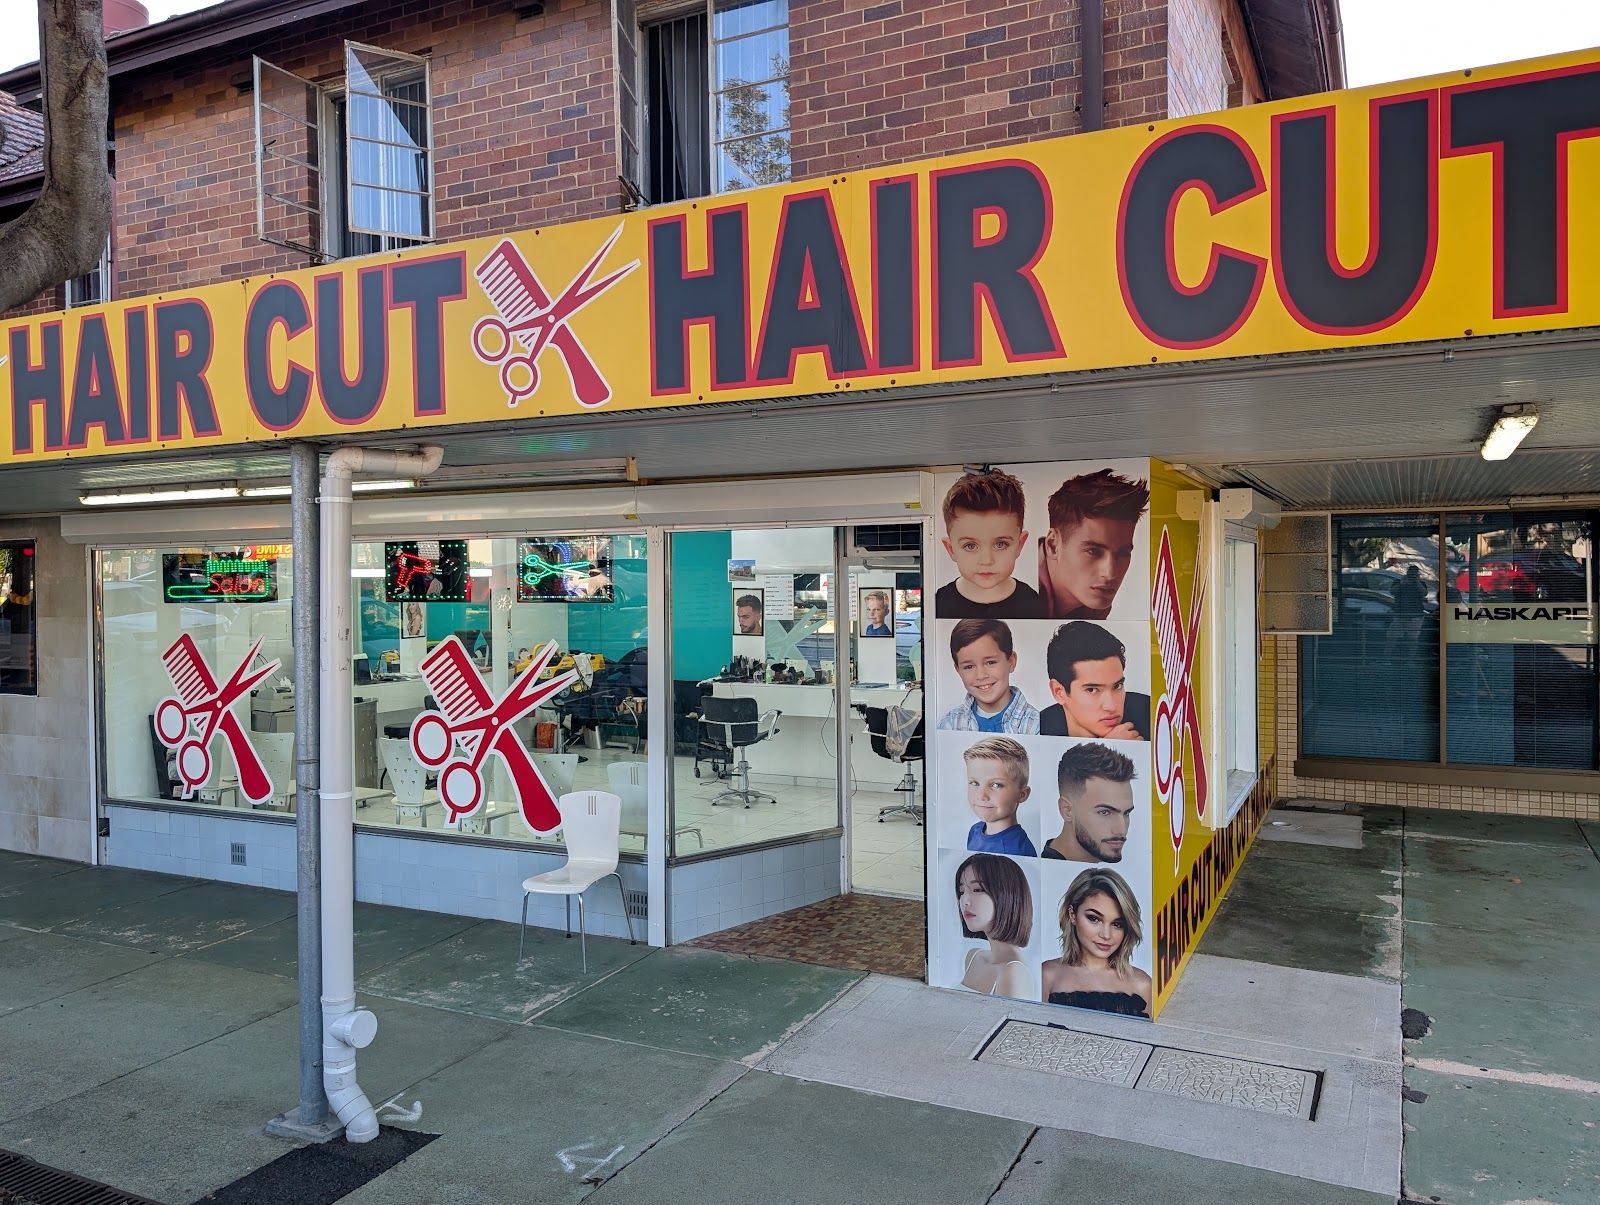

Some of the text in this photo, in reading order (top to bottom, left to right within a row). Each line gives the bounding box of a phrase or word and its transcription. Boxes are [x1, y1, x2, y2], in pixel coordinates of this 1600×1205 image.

[648, 62, 1600, 397] HAIR CUT
[10, 251, 467, 455] HAIR CUT
[207, 573, 265, 593] Salon
[1156, 874, 1190, 998] HAIR
[1190, 840, 1213, 935] CUT
[1214, 822, 1235, 900] HAIR
